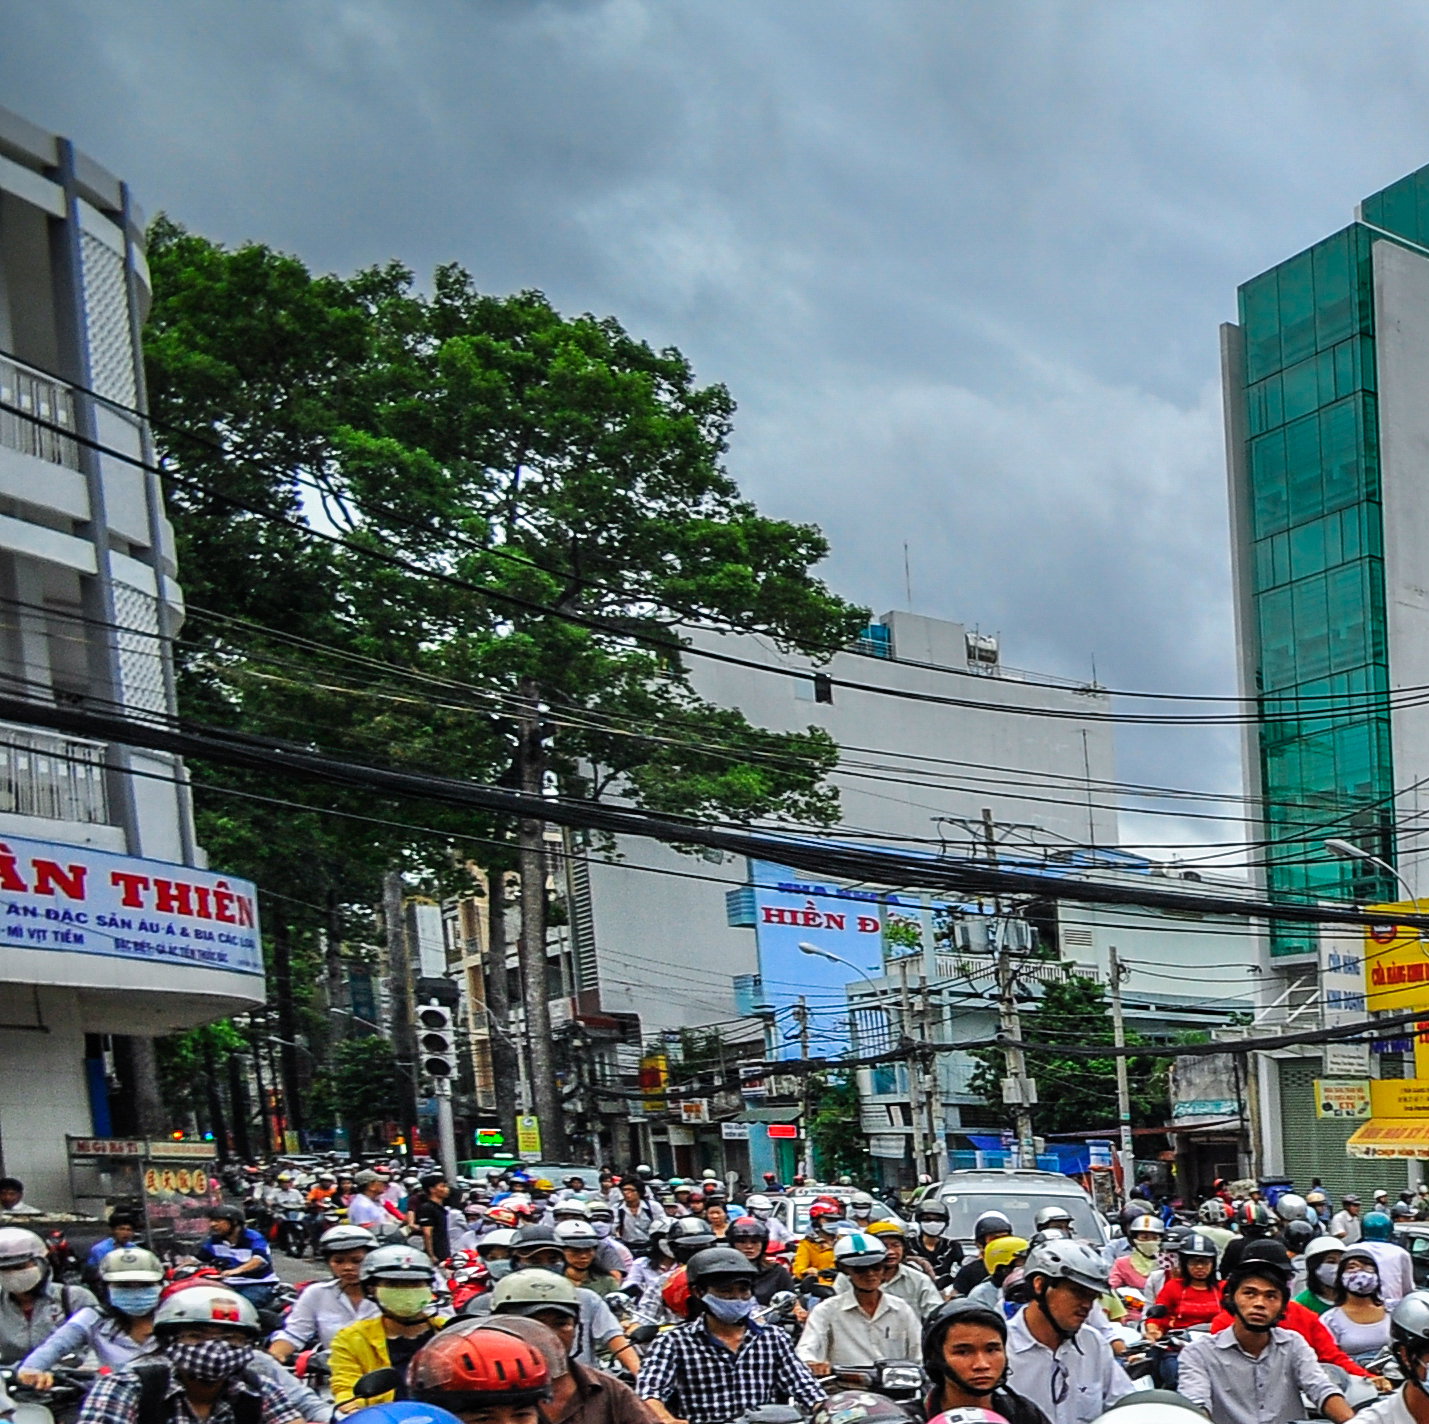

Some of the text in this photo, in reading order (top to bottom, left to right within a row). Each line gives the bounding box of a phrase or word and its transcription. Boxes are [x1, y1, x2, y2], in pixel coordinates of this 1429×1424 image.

[111, 871, 256, 929] THIÊN
[761, 899, 846, 931] HIỀN
[180, 926, 190, 938] &
